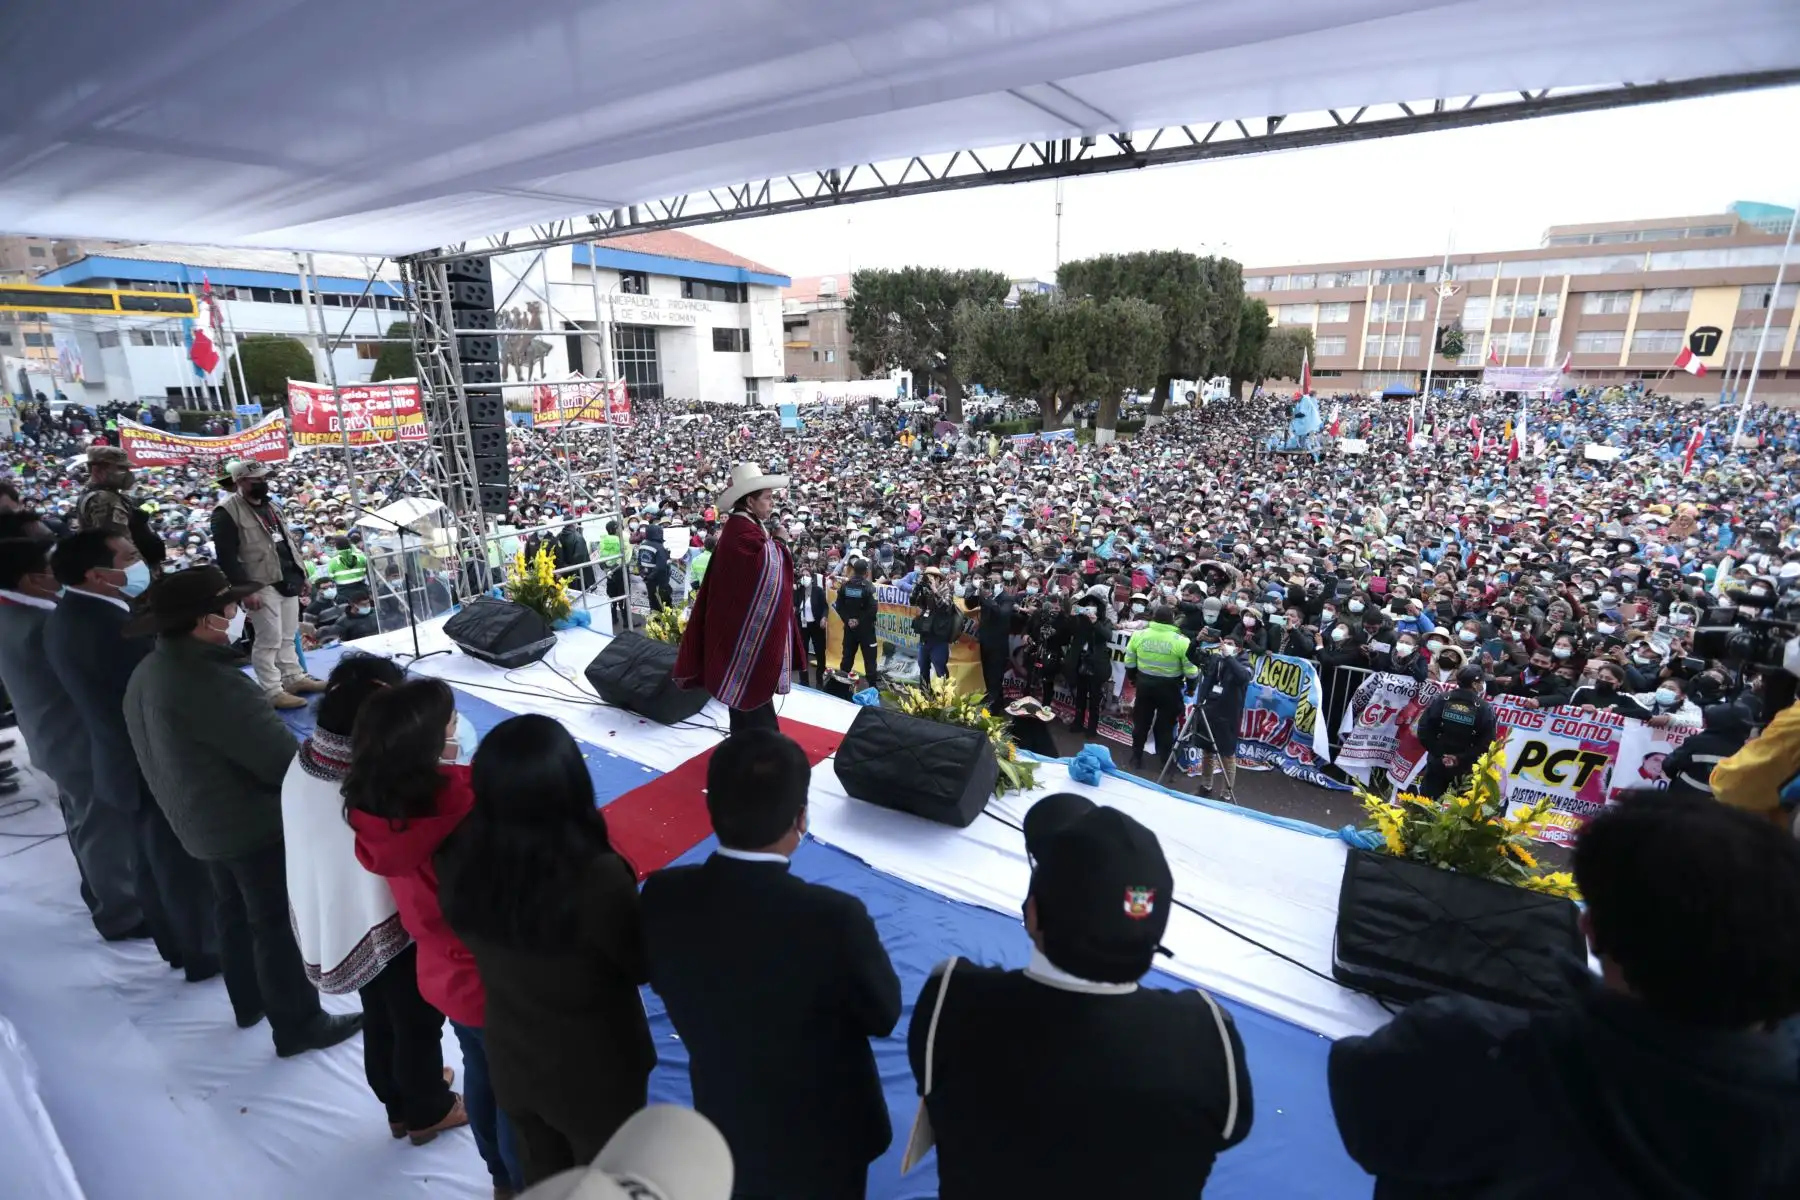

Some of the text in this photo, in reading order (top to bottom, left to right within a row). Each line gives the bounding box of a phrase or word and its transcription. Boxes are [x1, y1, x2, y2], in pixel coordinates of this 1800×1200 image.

[621, 309, 633, 320] DE
[668, 299, 712, 313] PROVINCIAL
[365, 397, 416, 410] Casillo
[194, 446, 229, 455] EXIGE
[271, 430, 284, 441] LA
[1256, 654, 1302, 697] AGUA
[1386, 682, 1416, 699] COMO
[1550, 717, 1613, 743] COMO
[1510, 740, 1609, 789] PCT
[1562, 796, 1590, 815] PEDRO
